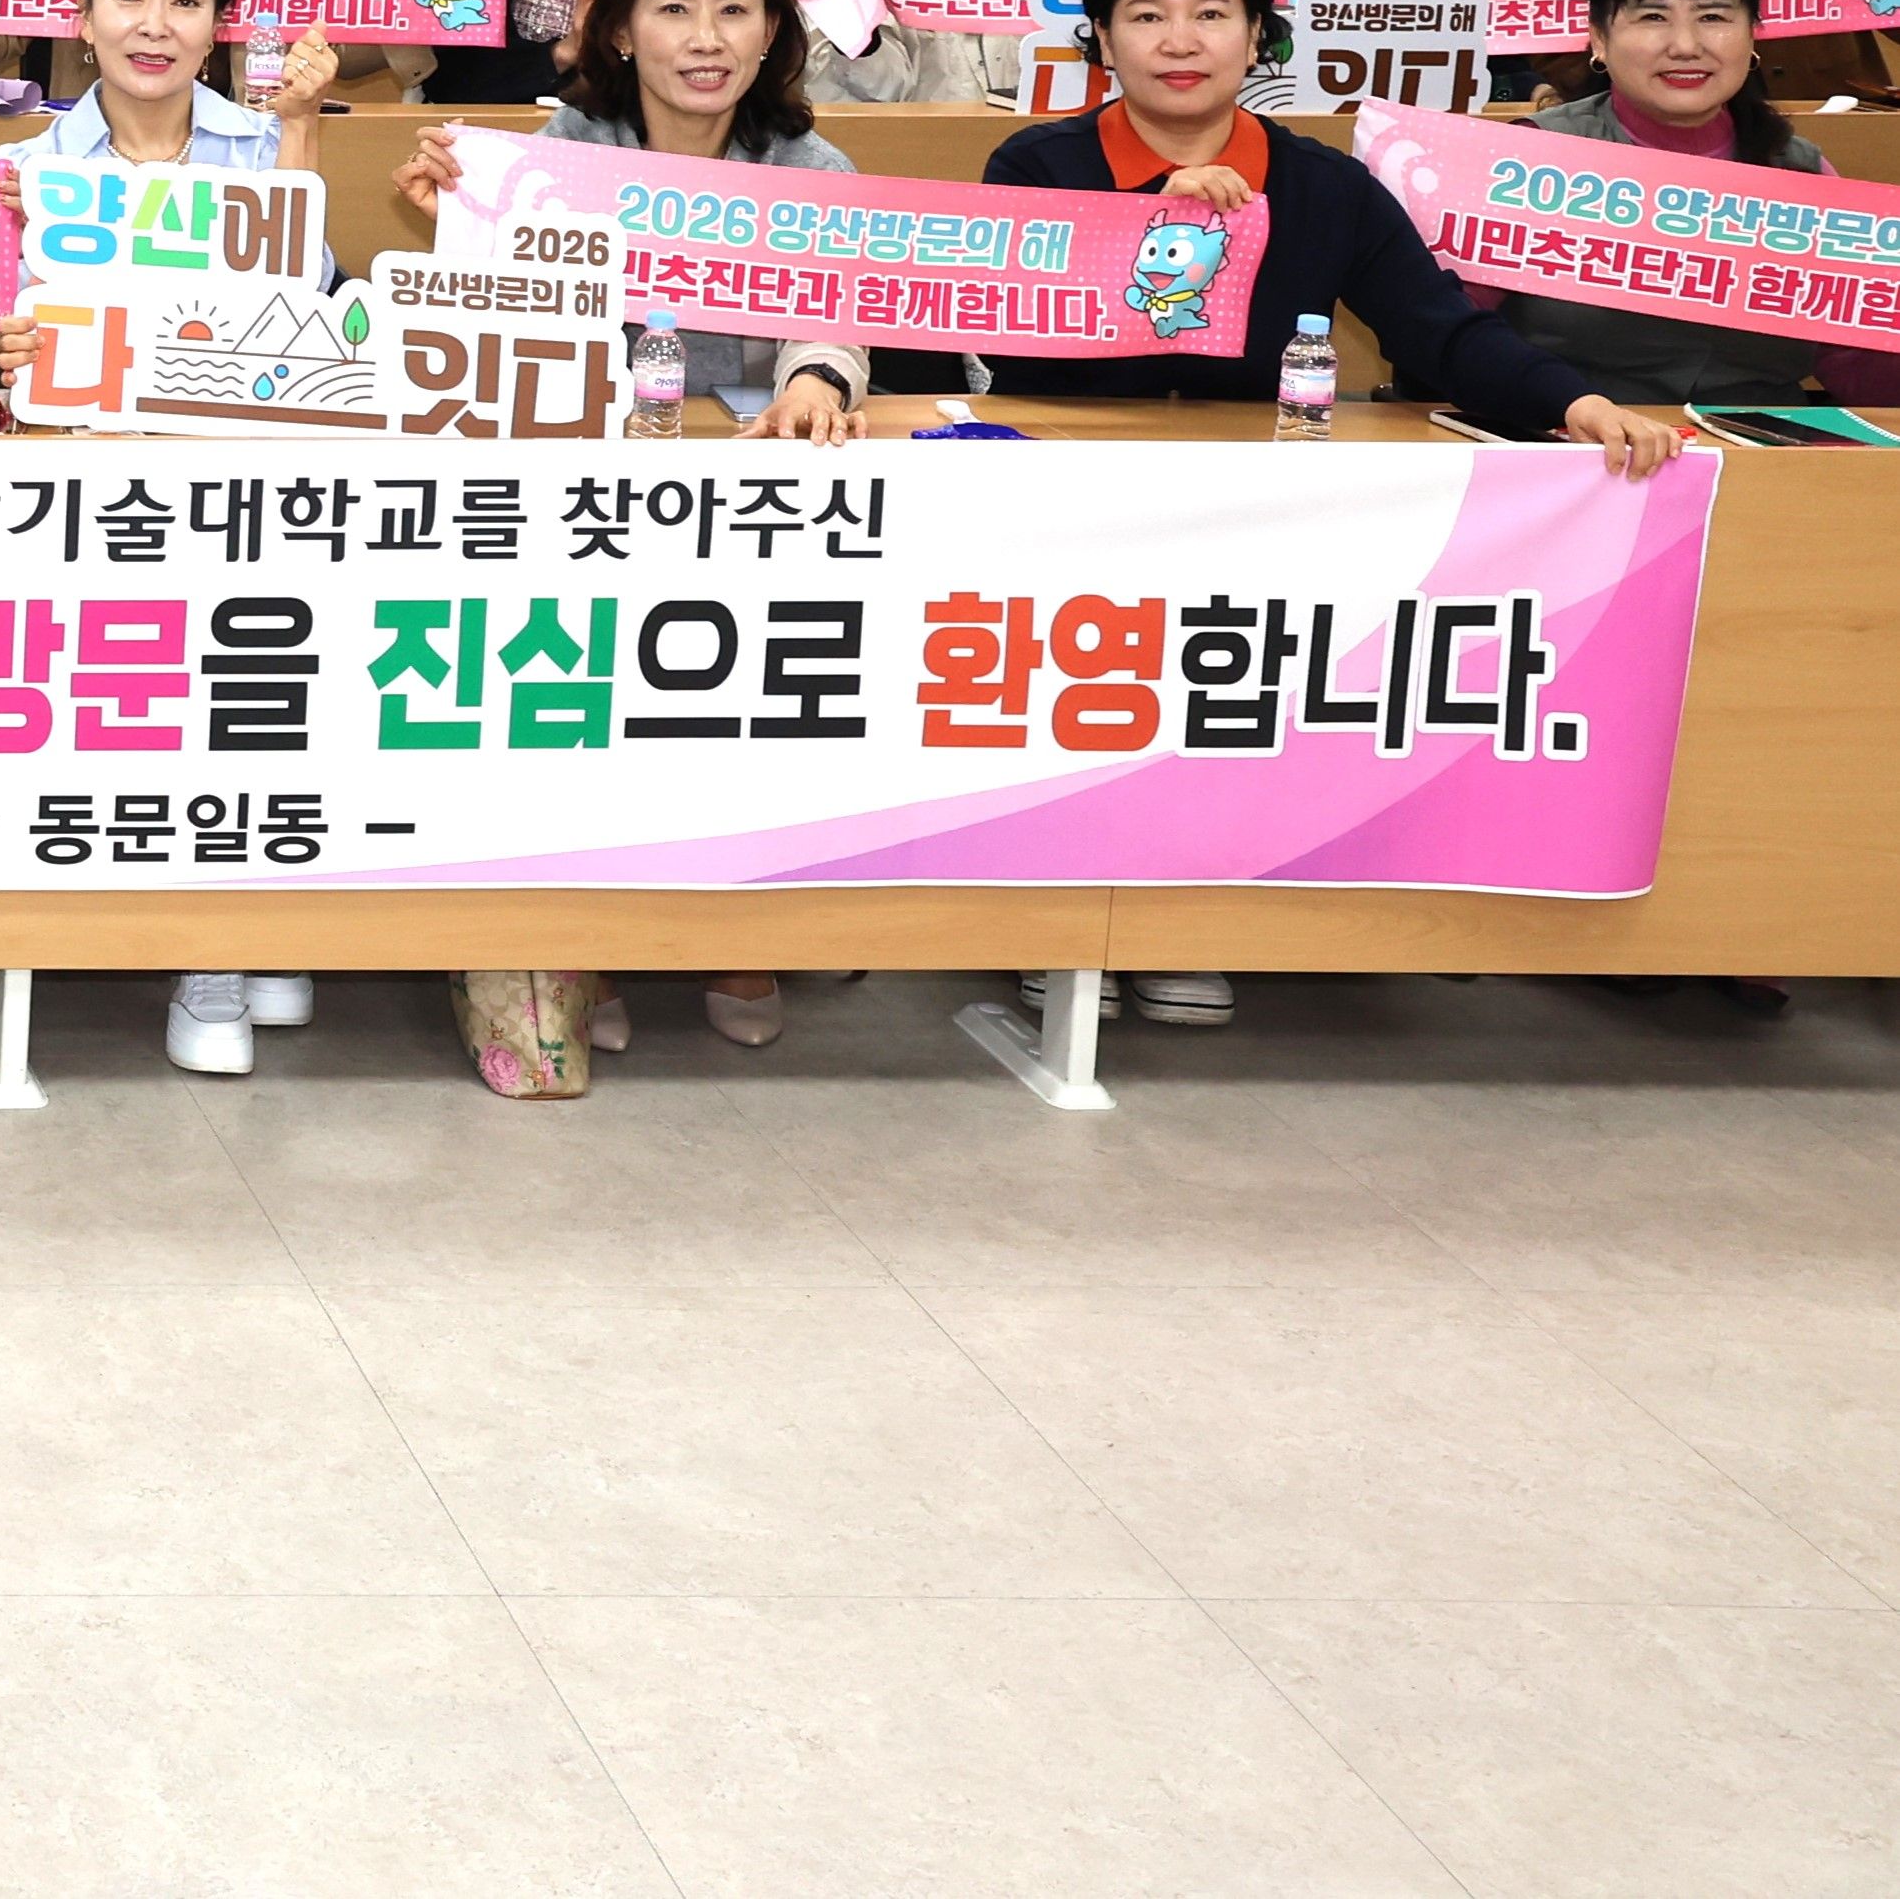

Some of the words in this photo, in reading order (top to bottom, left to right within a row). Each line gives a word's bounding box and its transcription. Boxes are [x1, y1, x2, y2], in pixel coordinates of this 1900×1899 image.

[1311, 2, 1441, 32] 양산방문의
[1449, 1, 1475, 32] 해
[1318, 49, 1478, 113] 잇다
[41, 170, 308, 276] 양산에
[617, 185, 755, 245] 2026
[769, 206, 1009, 267] 양산방문의
[1021, 221, 1070, 270] 해
[1490, 159, 1643, 225] 2026
[513, 226, 610, 266] 2026
[1430, 212, 1736, 304] 시민추진단과
[391, 268, 565, 316] 양산방문의
[574, 281, 607, 317] 해
[856, 274, 1119, 339] 함께합니다.
[29, 304, 134, 412] 다
[401, 329, 615, 437] 잇다
[561, 476, 887, 562] 찾아주신
[369, 596, 867, 748] 진심으로
[917, 592, 1584, 758] 환영합니다.
[29, 792, 329, 866] 동문일동
